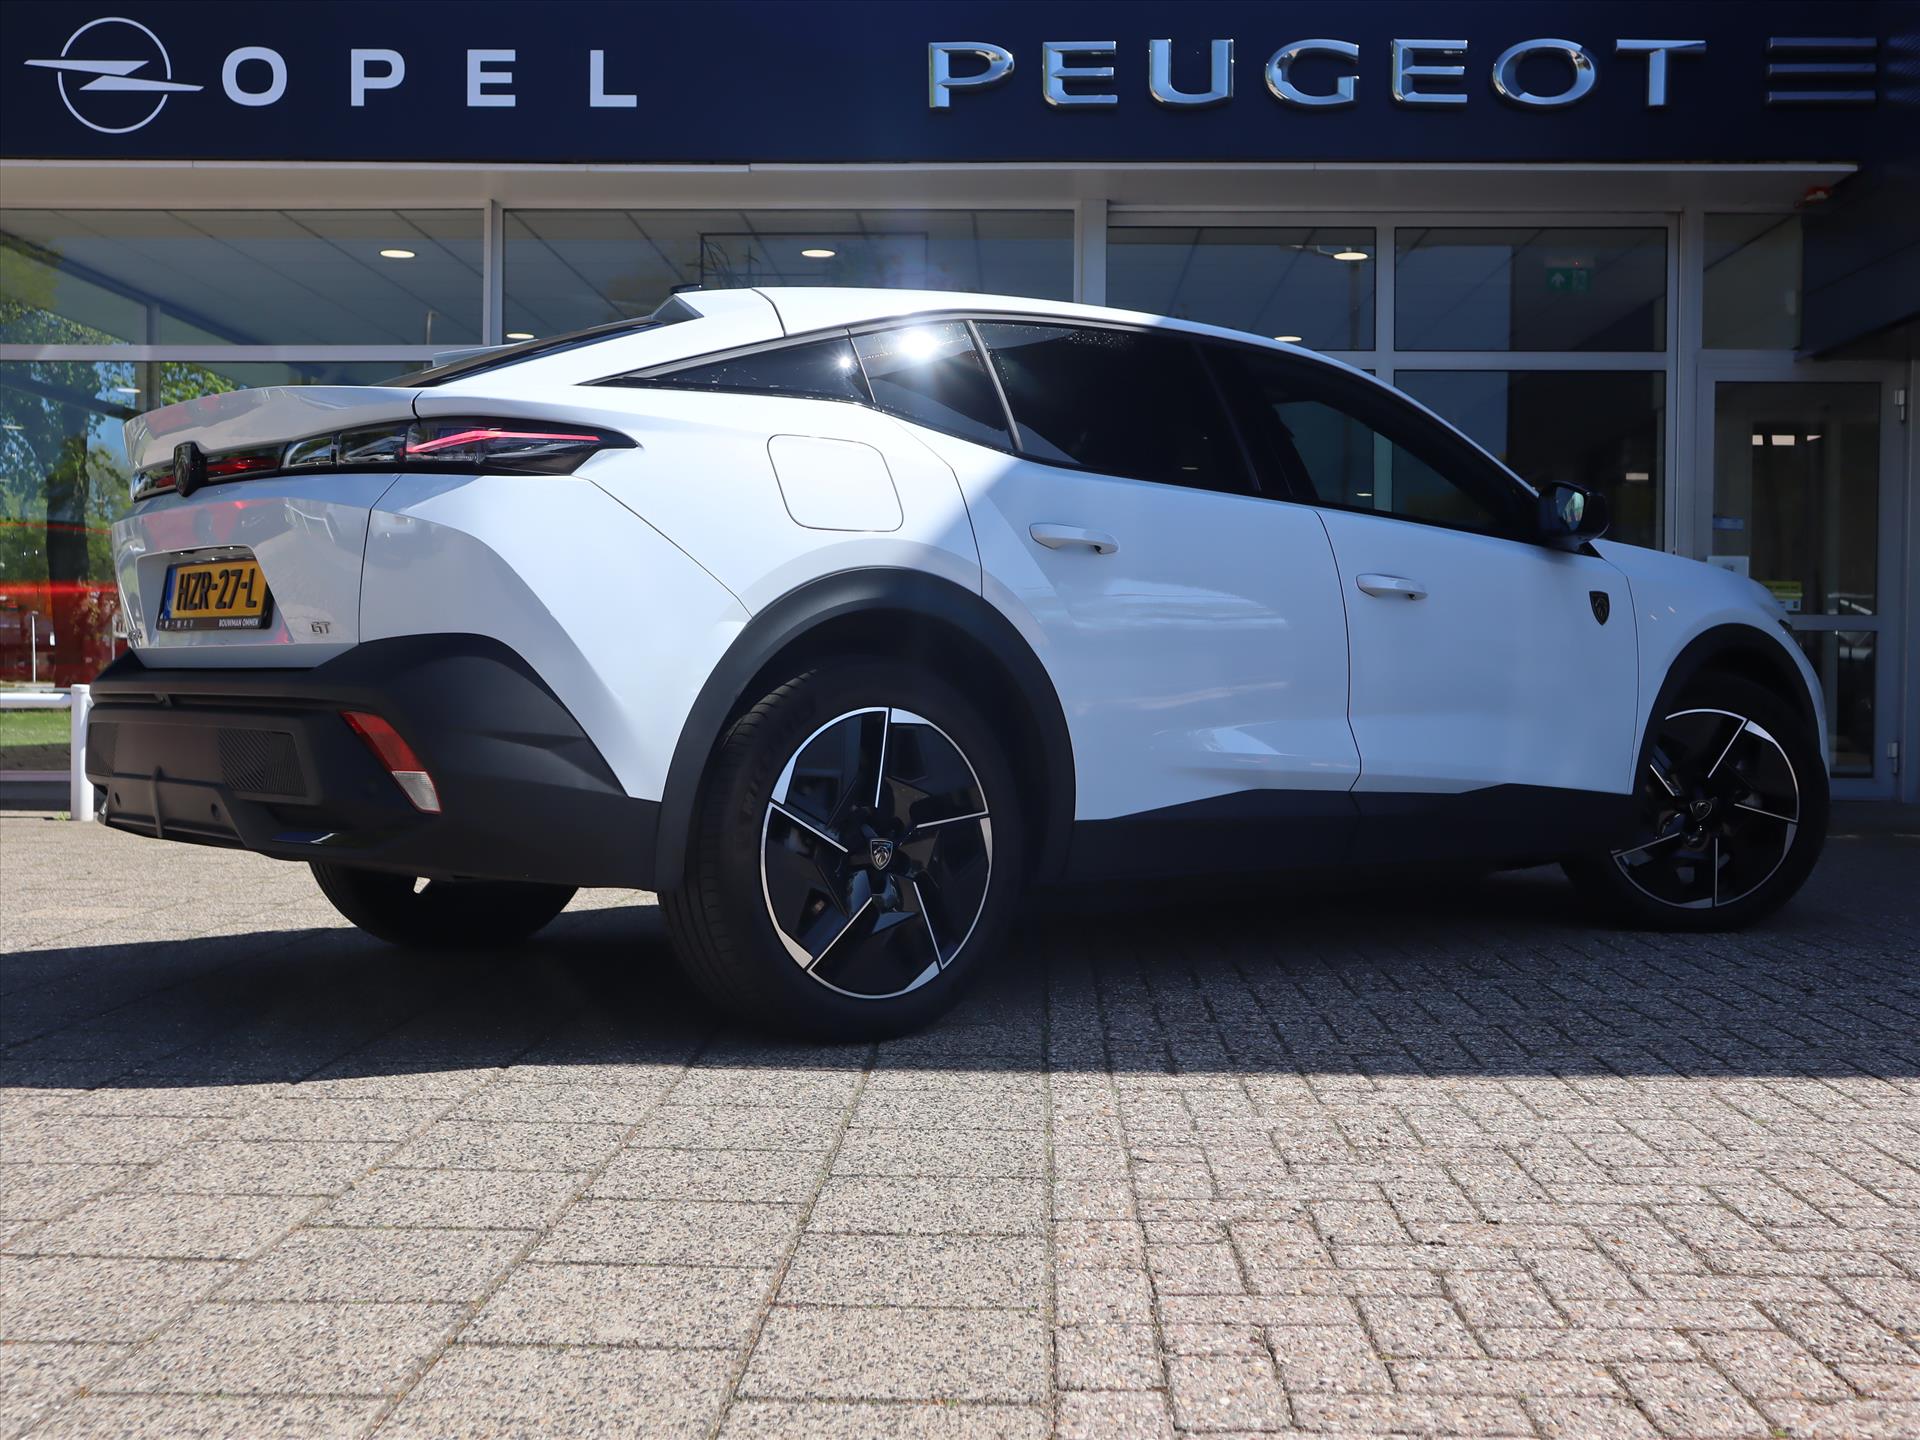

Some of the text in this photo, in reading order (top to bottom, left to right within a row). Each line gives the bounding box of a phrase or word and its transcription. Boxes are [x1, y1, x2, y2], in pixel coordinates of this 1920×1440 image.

[222, 47, 637, 107] OPEL
[929, 39, 1705, 107] PEUGEOT
[175, 567, 257, 611] HZR-27-L
[310, 621, 331, 634] GT
